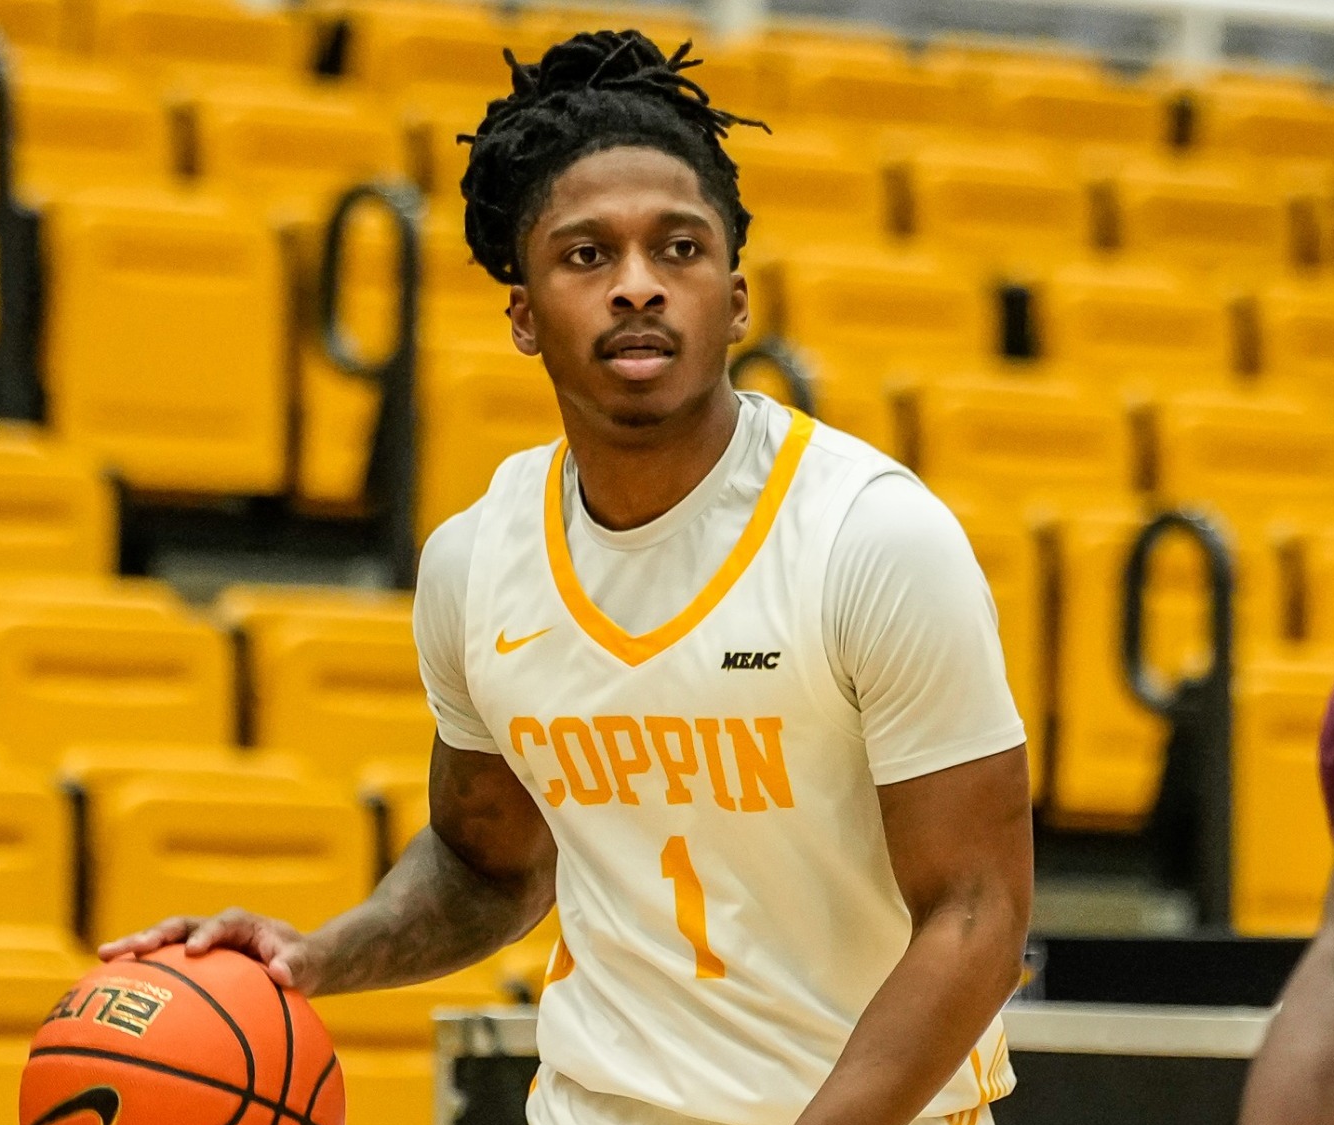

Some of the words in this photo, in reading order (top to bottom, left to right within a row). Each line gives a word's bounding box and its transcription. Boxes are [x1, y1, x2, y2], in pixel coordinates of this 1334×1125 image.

[720, 651, 781, 671] MEAC
[508, 715, 795, 813] COPPIN
[660, 835, 725, 979] 1
